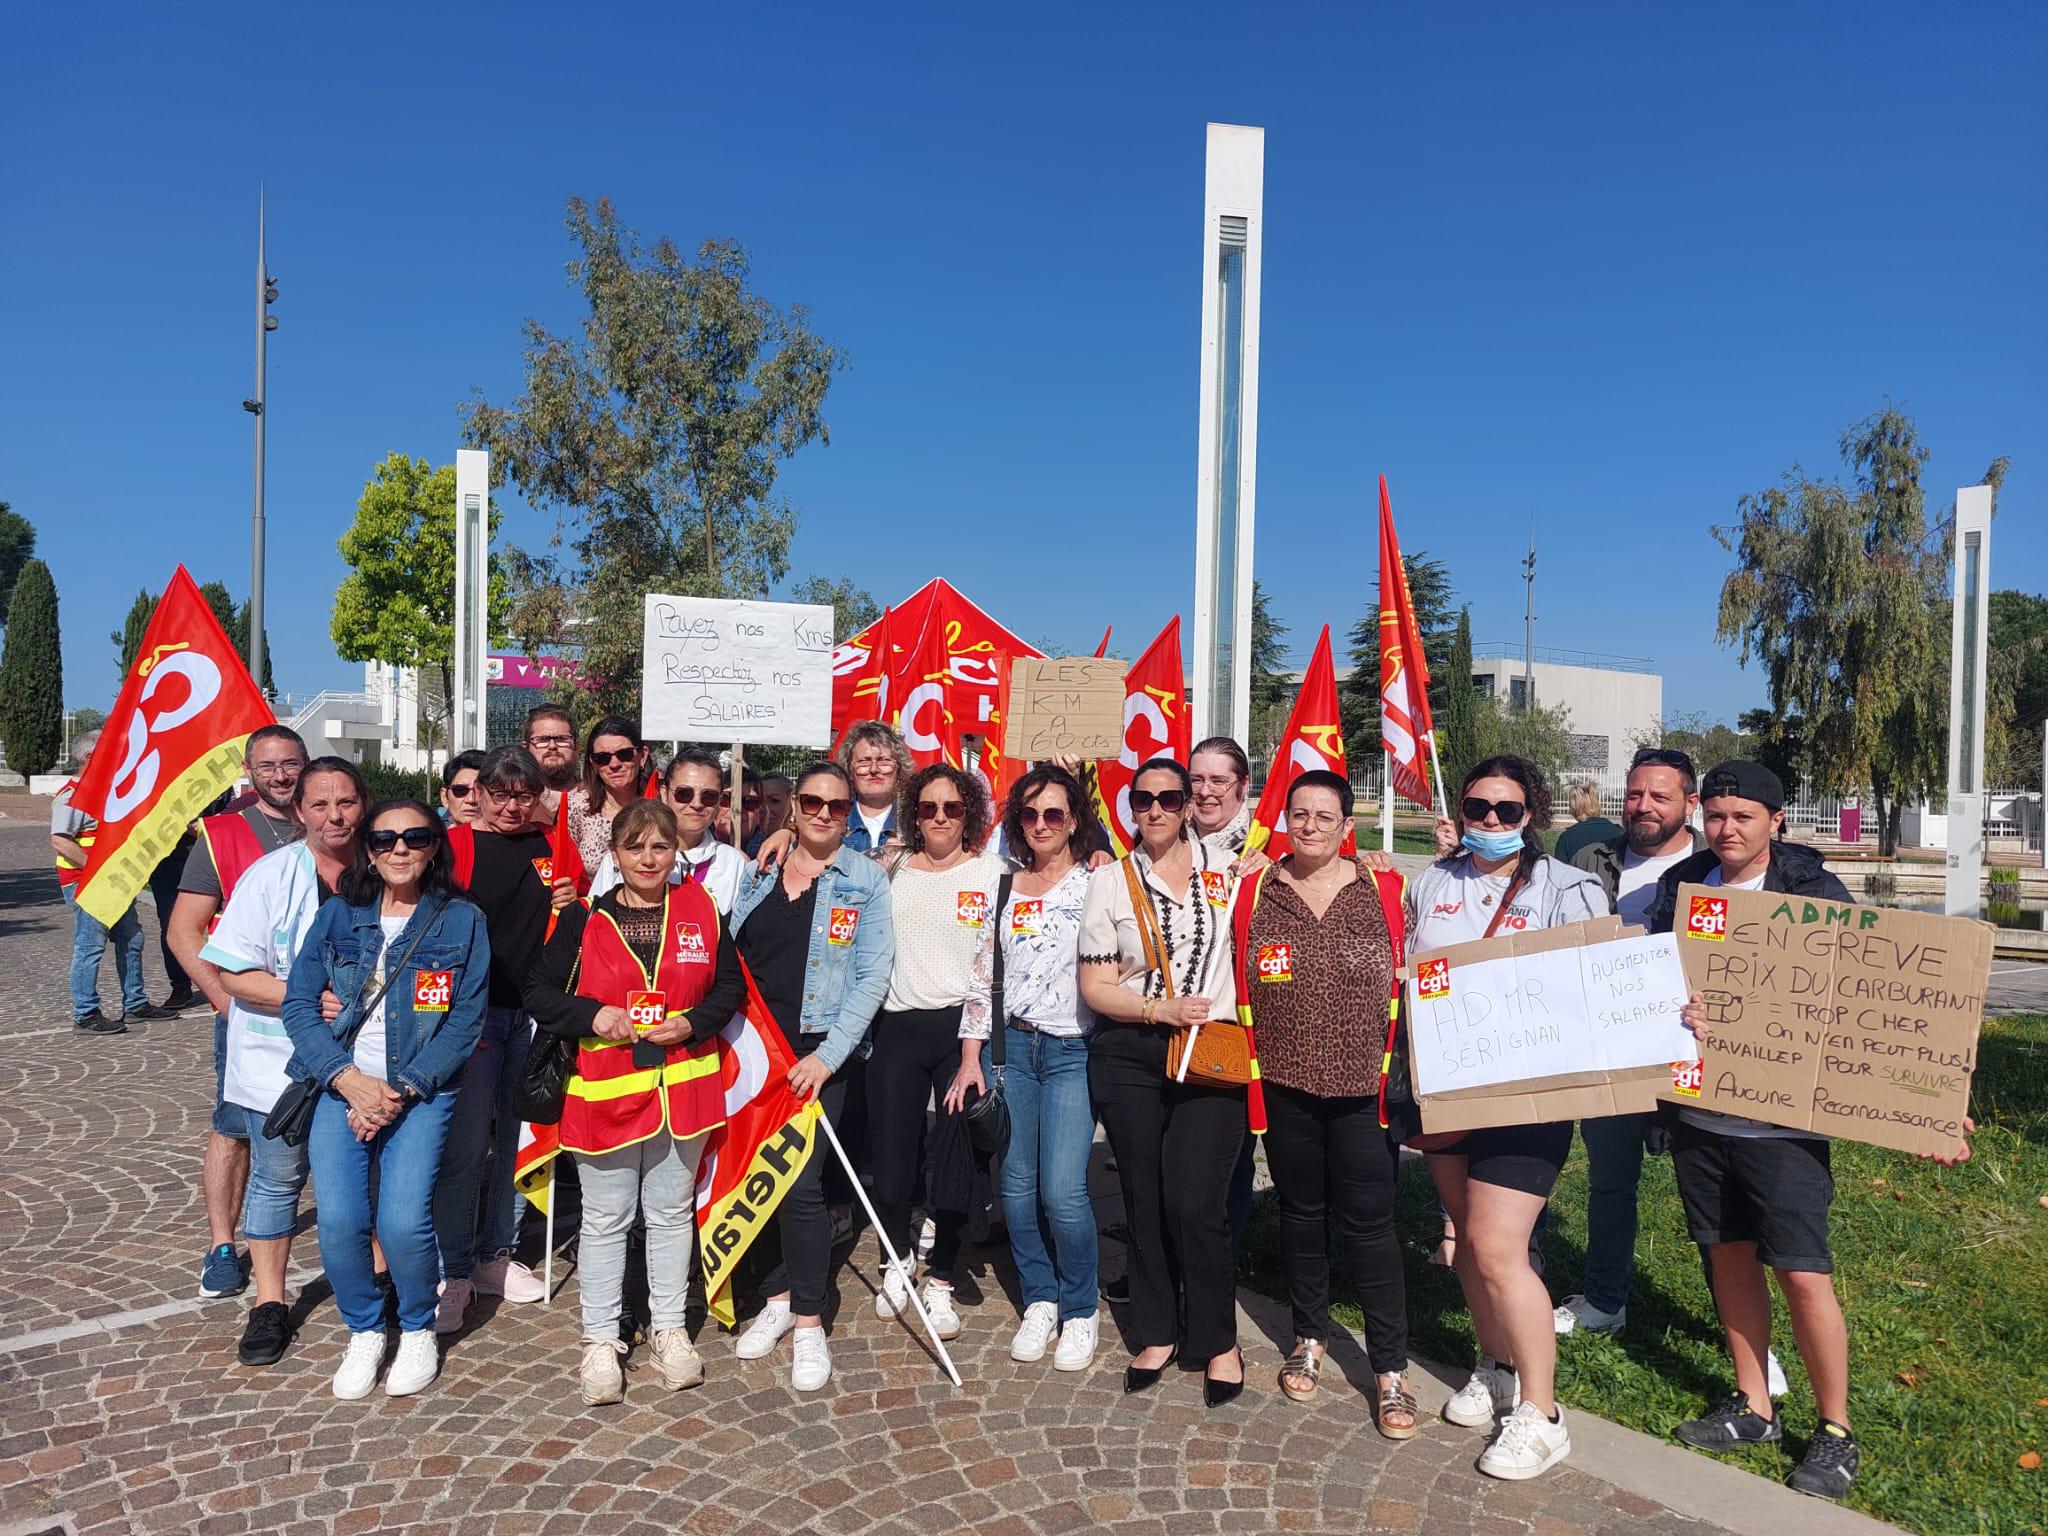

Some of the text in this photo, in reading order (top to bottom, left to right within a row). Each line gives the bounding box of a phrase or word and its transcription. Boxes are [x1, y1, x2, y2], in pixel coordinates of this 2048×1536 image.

[654, 603, 832, 652] Payez nos Kms
[773, 671, 801, 686] nos
[1036, 664, 1093, 685] LES
[1032, 692, 1081, 714] KM
[1030, 730, 1074, 752] 60
[1506, 906, 1531, 917] ANU
[1770, 900, 1880, 930] ADMR
[1691, 913, 1726, 933] cgt
[680, 933, 704, 949] cgt
[1732, 923, 1948, 978] EN GREVE
[1260, 956, 1290, 975] cgt
[1591, 948, 1672, 984] AUGMENTER
[1420, 970, 1449, 992] cgt
[1789, 965, 1829, 996] DU
[1837, 975, 1981, 1013] CARBURANT
[417, 985, 450, 1005] cgt
[630, 1004, 663, 1024] cgt
[1431, 978, 1550, 1044] ADMR
[1790, 1001, 1848, 1024] TROP
[1857, 1009, 1929, 1037] CHER
[1862, 1038, 1914, 1057] PEUT
[1824, 1055, 1874, 1077] POUR
[1714, 1071, 1959, 1138] Aucune Reconnaissance
